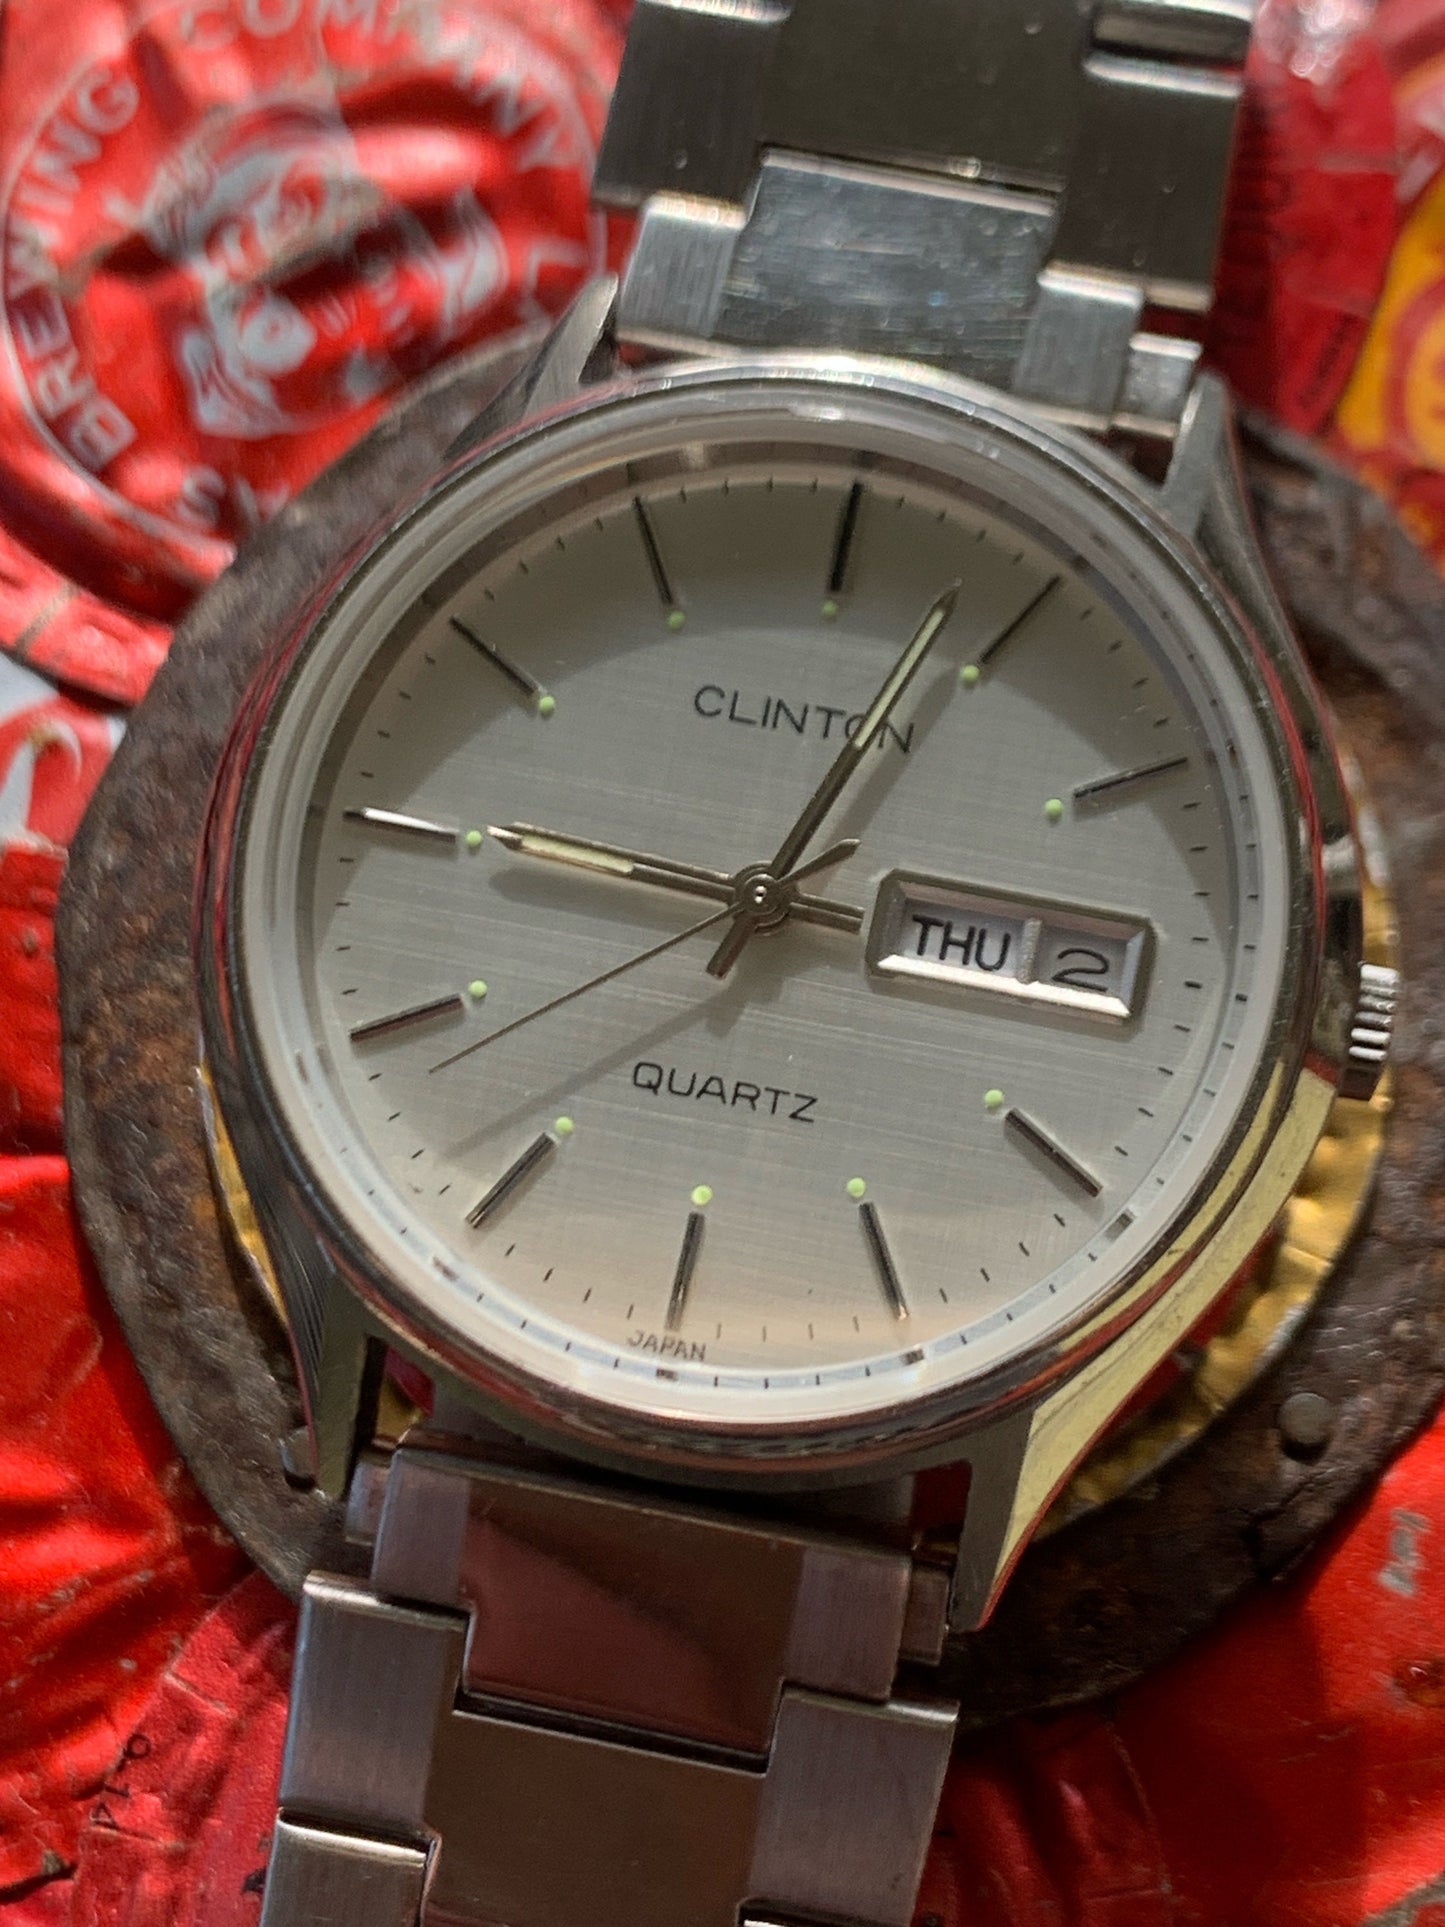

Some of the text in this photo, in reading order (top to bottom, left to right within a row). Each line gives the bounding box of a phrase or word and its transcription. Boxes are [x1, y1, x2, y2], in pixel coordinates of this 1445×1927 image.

[912, 913, 1110, 993] THU 2
[632, 1060, 819, 1124] QUARTZ
[627, 1328, 707, 1362] JAPAN
